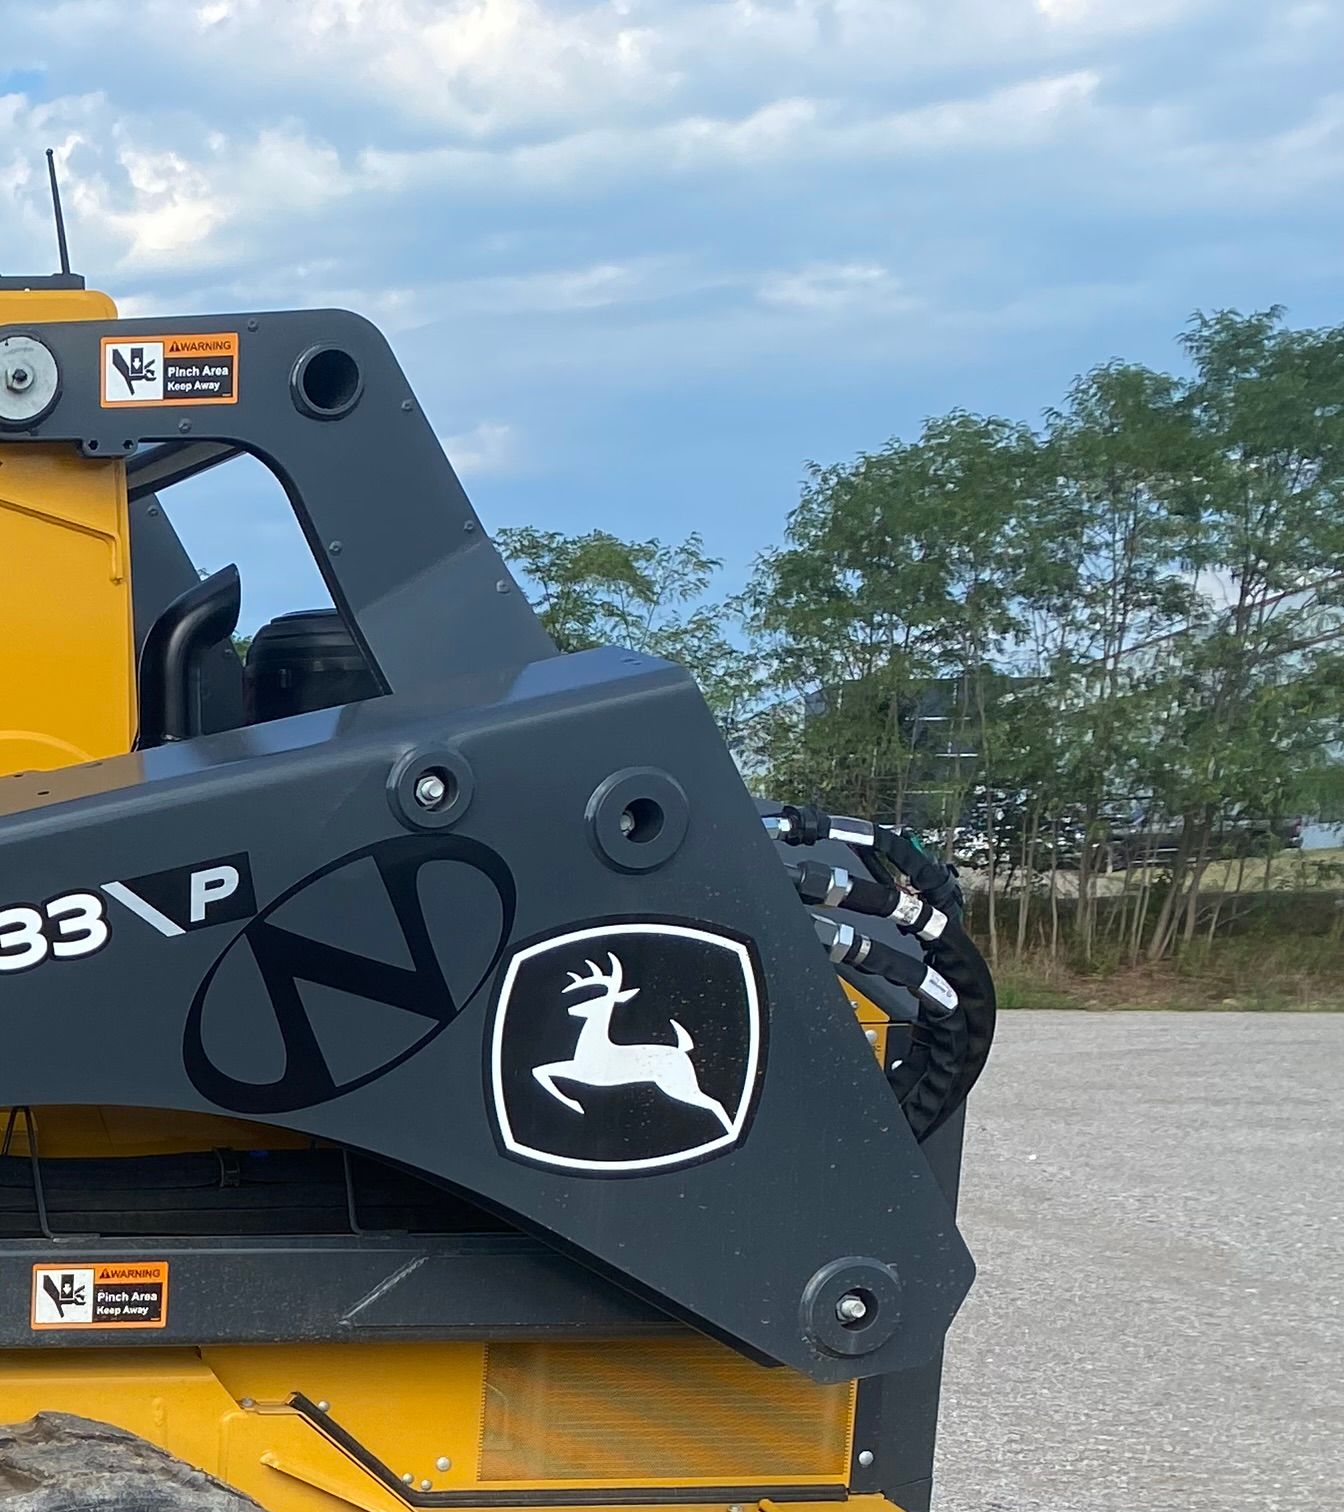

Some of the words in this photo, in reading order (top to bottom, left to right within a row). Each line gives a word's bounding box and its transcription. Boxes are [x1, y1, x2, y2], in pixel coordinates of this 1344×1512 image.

[180, 340, 232, 352] WARNING
[167, 366, 200, 377] Pinch
[202, 365, 229, 376] Area
[167, 381, 193, 393] Keep
[194, 380, 221, 393] Away
[110, 1268, 161, 1279] WARNING
[97, 1291, 129, 1303] Pinch
[131, 1291, 158, 1302] Area
[96, 1305, 121, 1316] Keep
[122, 1305, 149, 1316] Away
